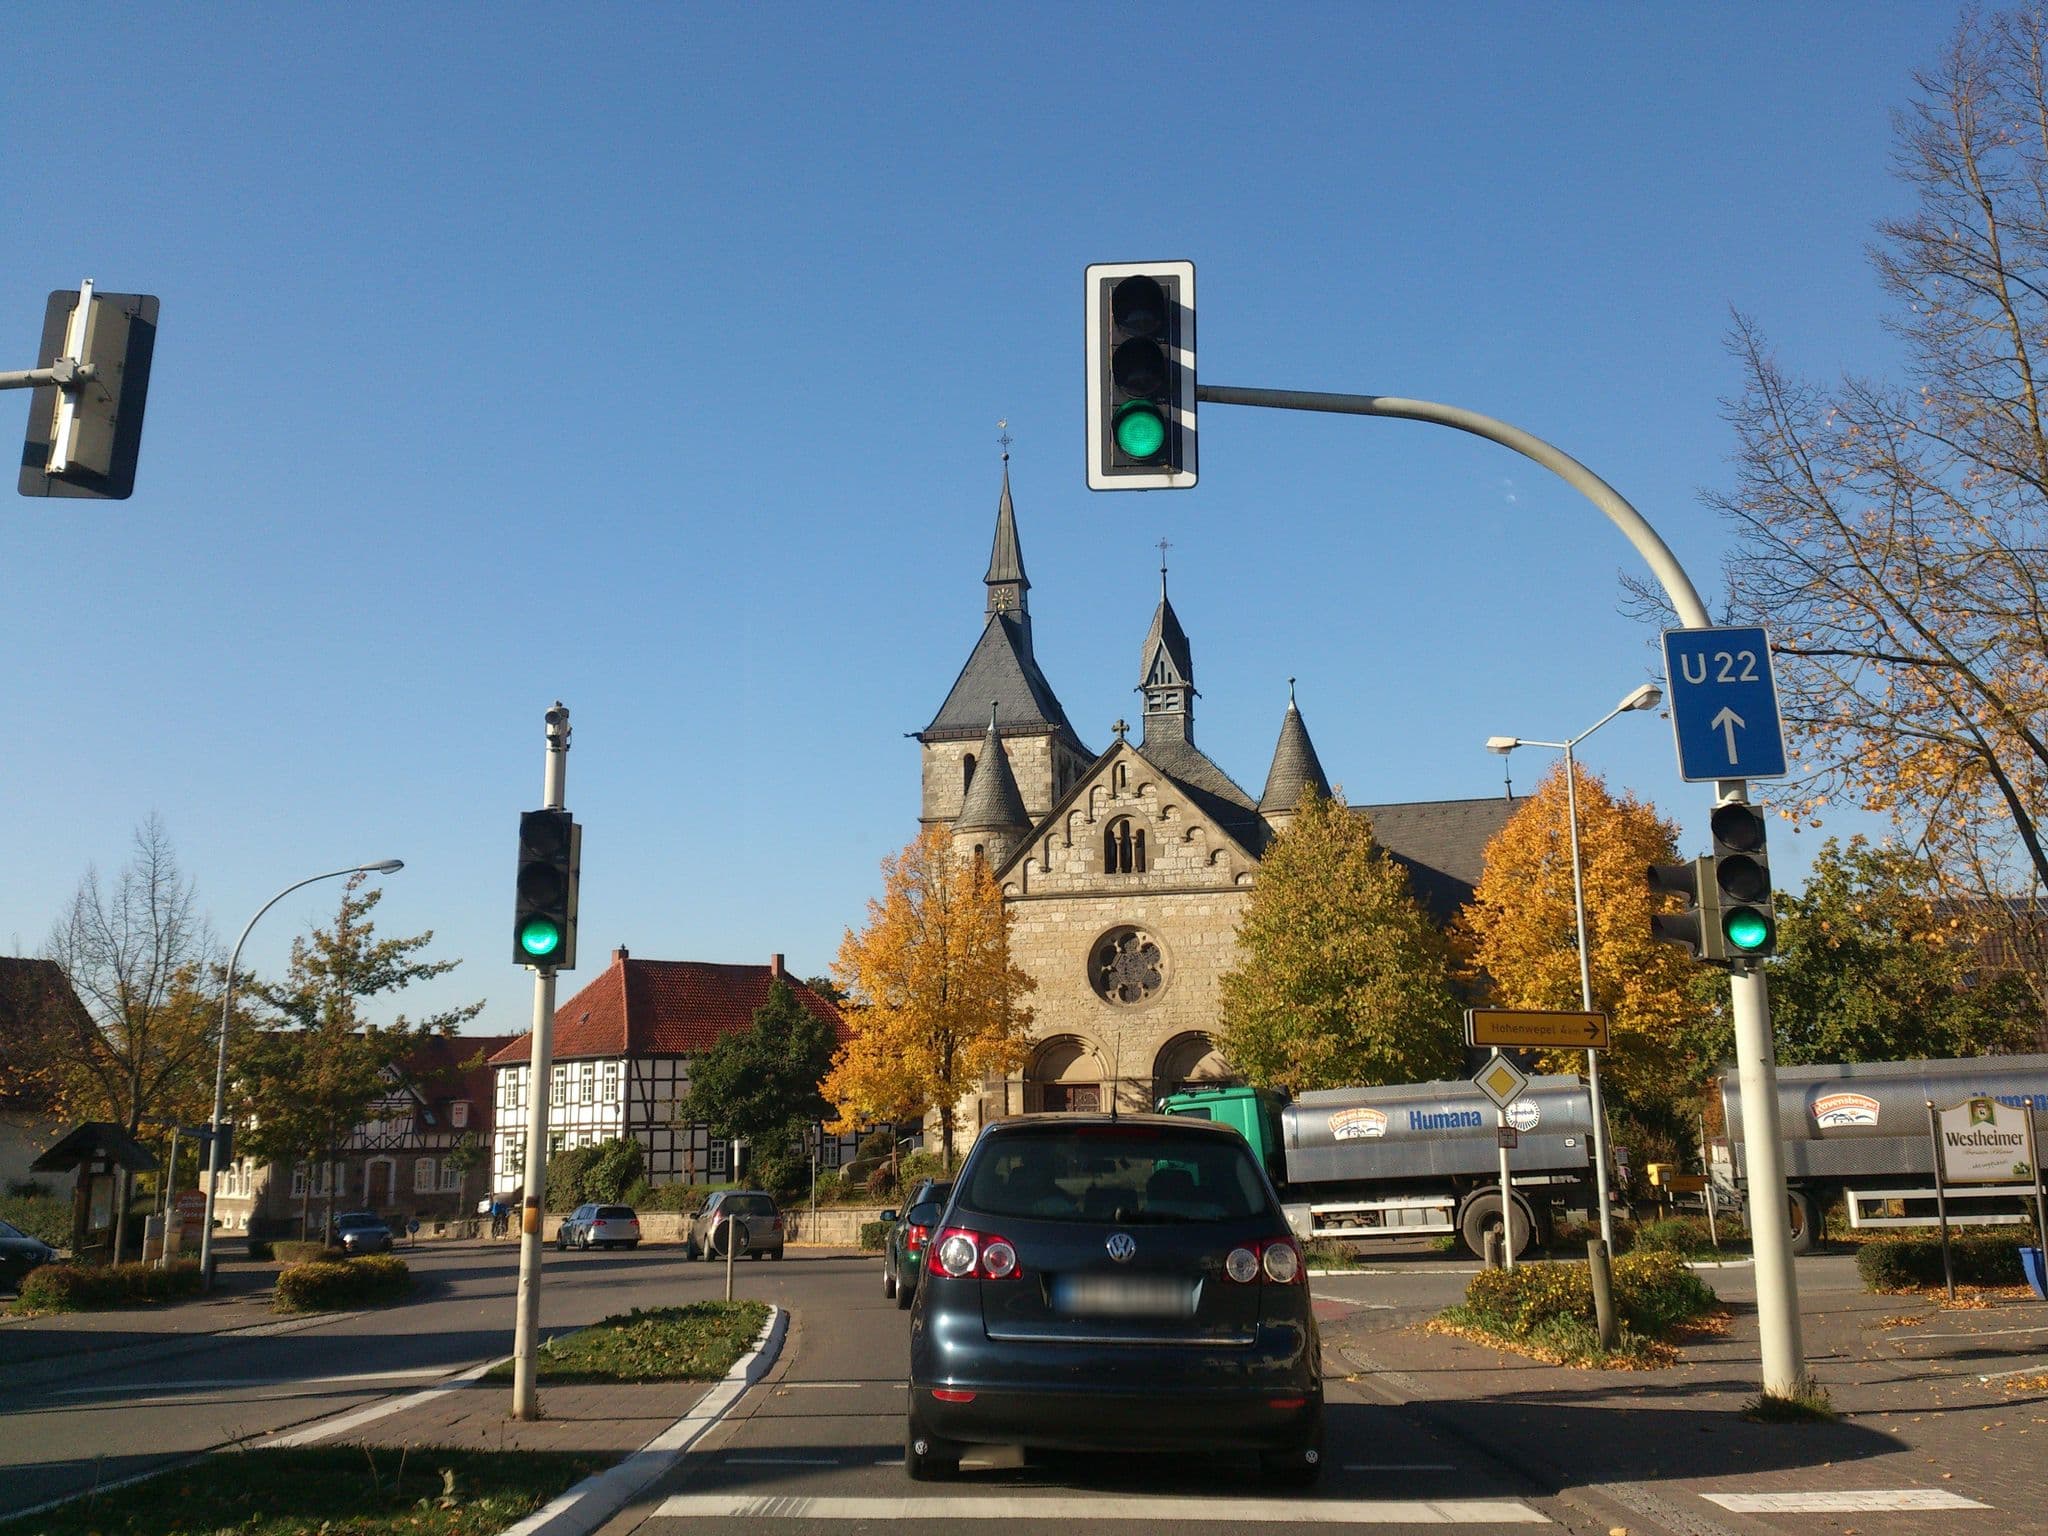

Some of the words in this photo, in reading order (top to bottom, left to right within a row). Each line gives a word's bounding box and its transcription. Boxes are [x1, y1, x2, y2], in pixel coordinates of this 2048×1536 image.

[1491, 1023, 1556, 1036] Hohenwepel
[1813, 1095, 1878, 1114] Ravensberger
[1409, 1110, 1482, 1130] Humana
[1945, 1129, 2024, 1147] Westheimer
